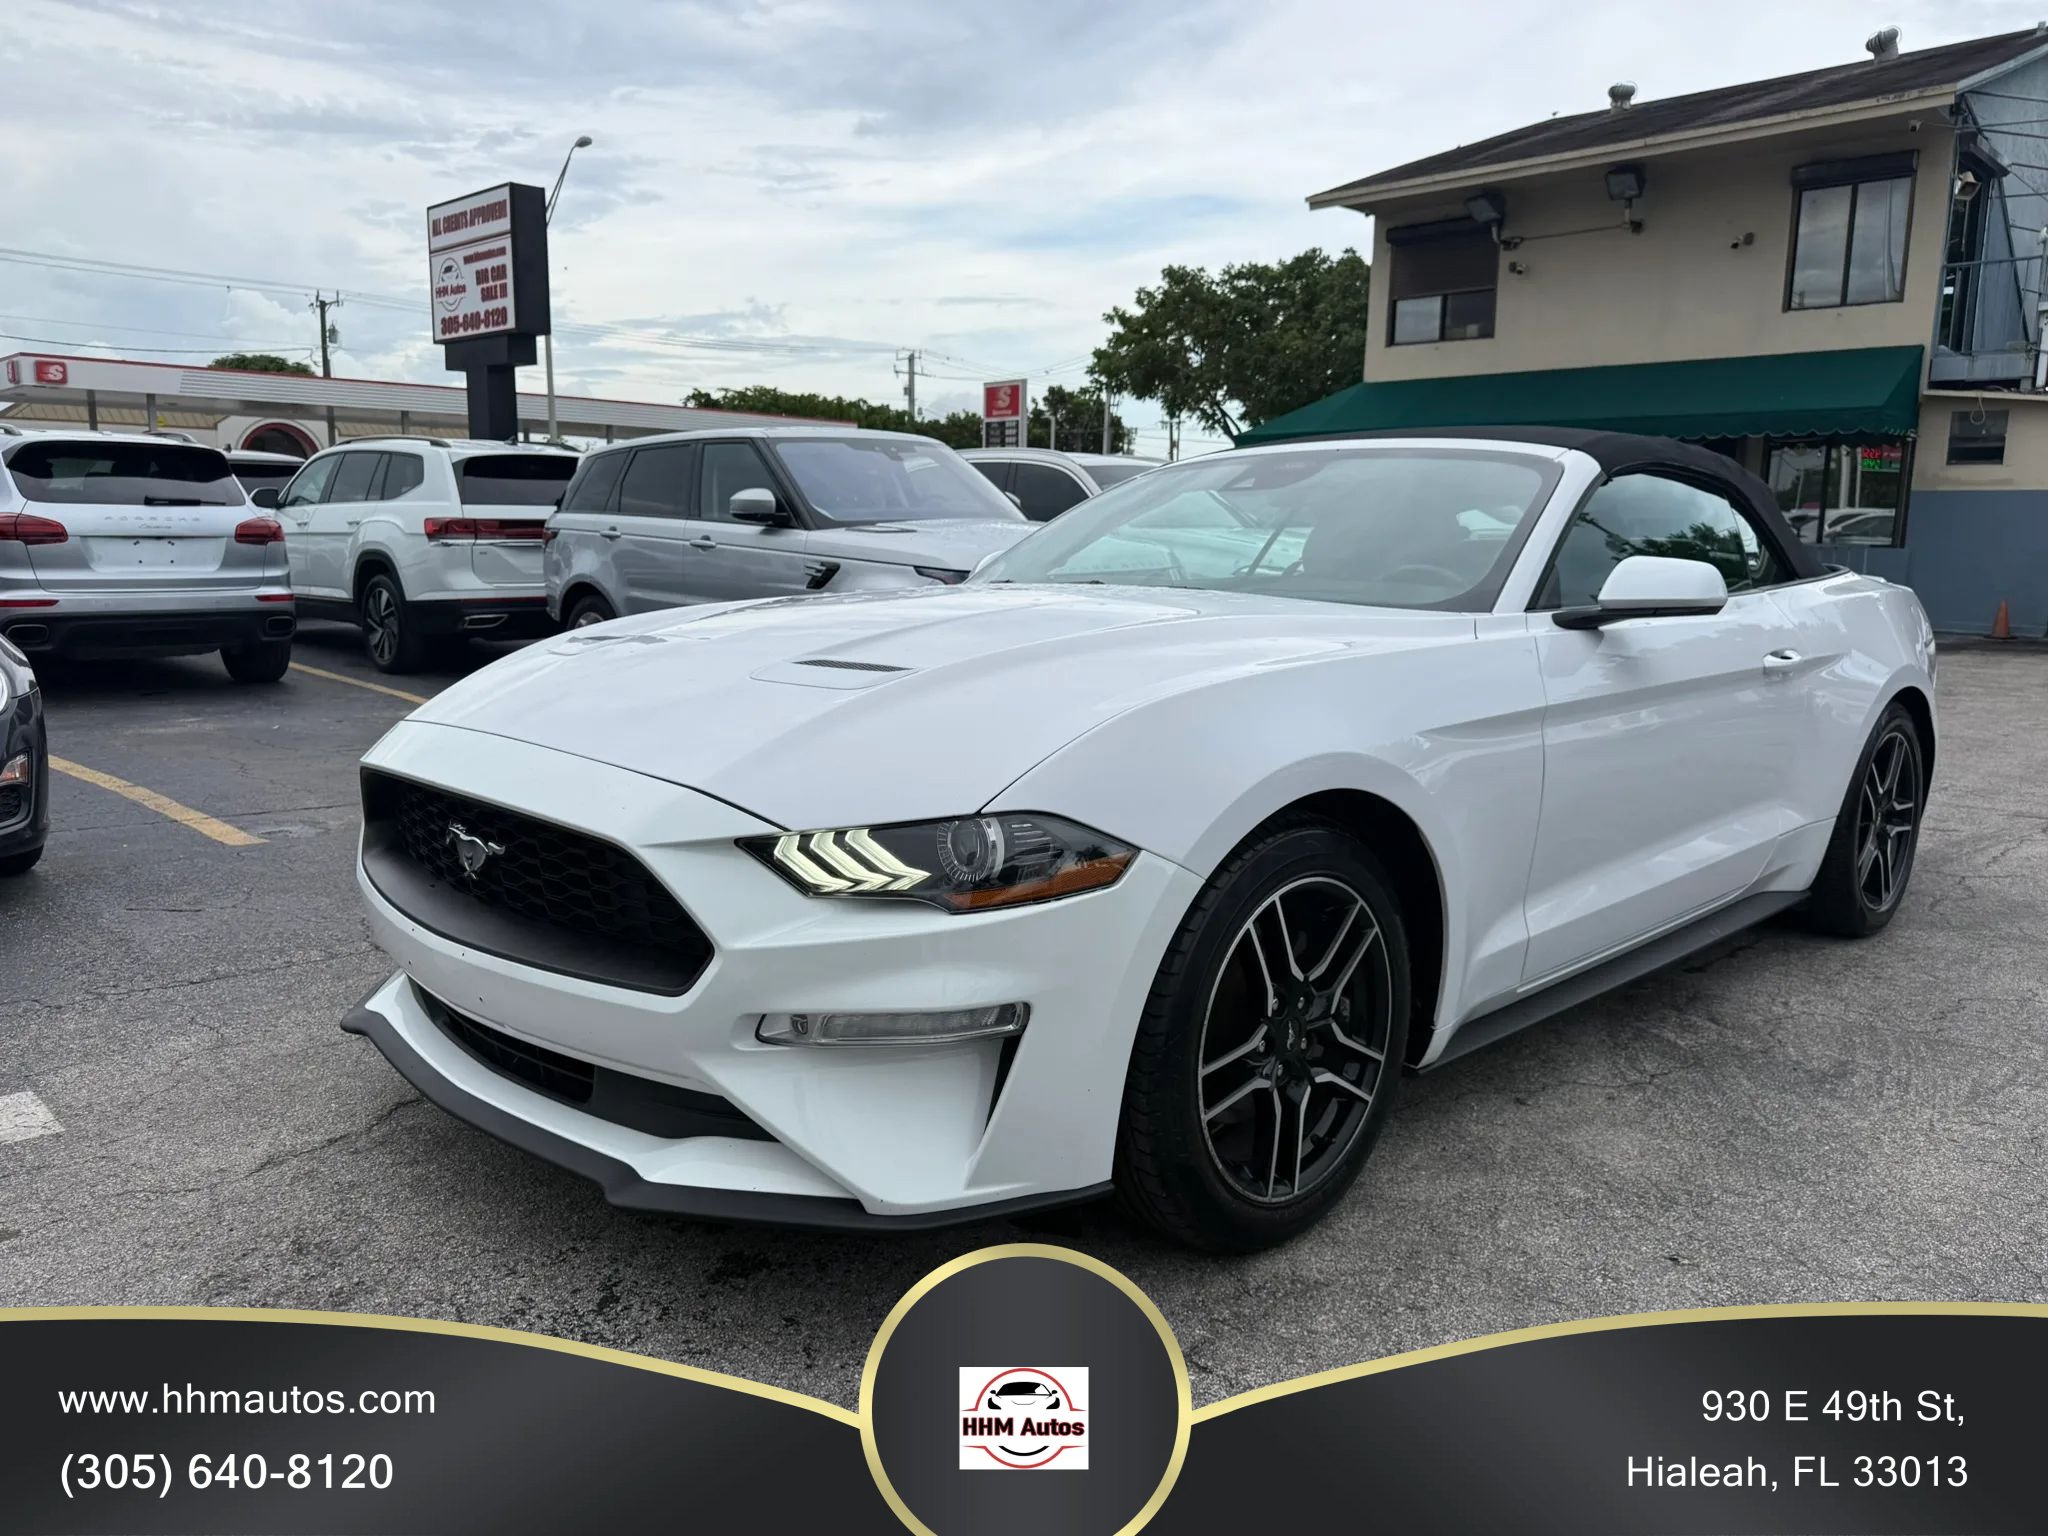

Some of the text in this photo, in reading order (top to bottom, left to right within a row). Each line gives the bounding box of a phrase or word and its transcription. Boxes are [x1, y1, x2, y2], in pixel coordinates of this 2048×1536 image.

[432, 216, 442, 237] ALL
[475, 264, 507, 285] BIG CAR
[481, 285, 498, 302] SALE
[441, 306, 507, 335] 305-640-8120
